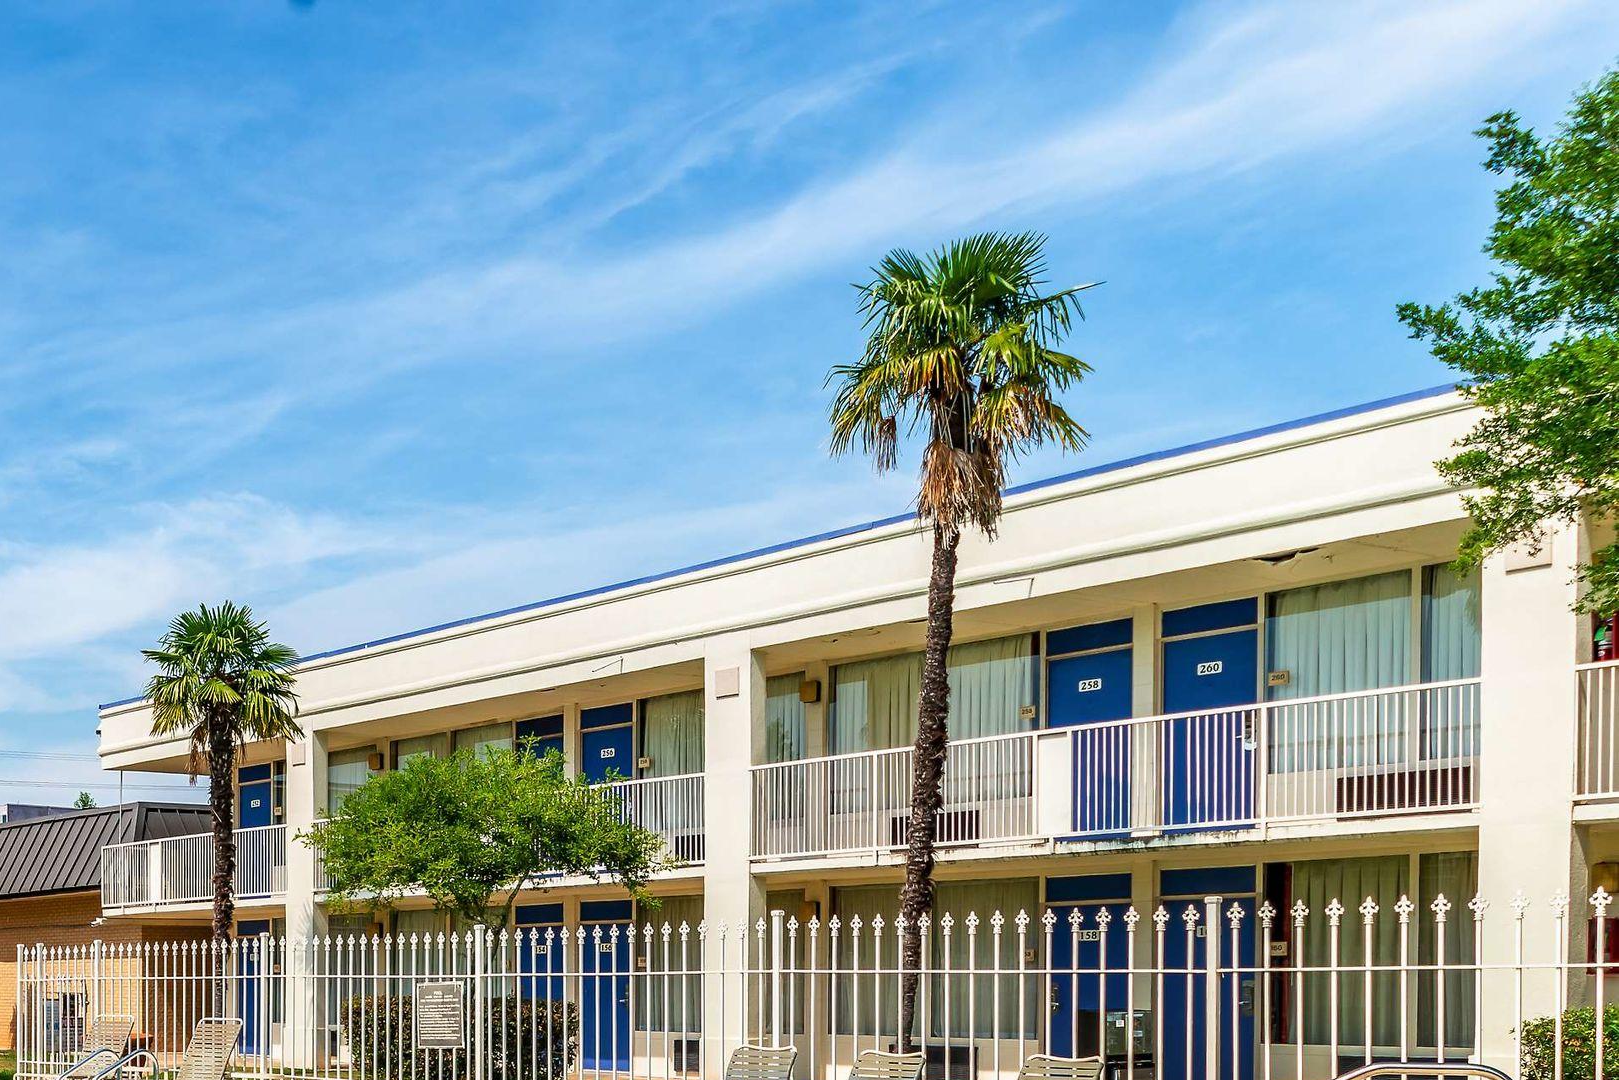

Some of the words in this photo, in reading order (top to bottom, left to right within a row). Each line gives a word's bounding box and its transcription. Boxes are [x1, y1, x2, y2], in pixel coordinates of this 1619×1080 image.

[1200, 662, 1219, 673] 260
[1081, 680, 1099, 690] 258
[1080, 931, 1097, 940] 158
